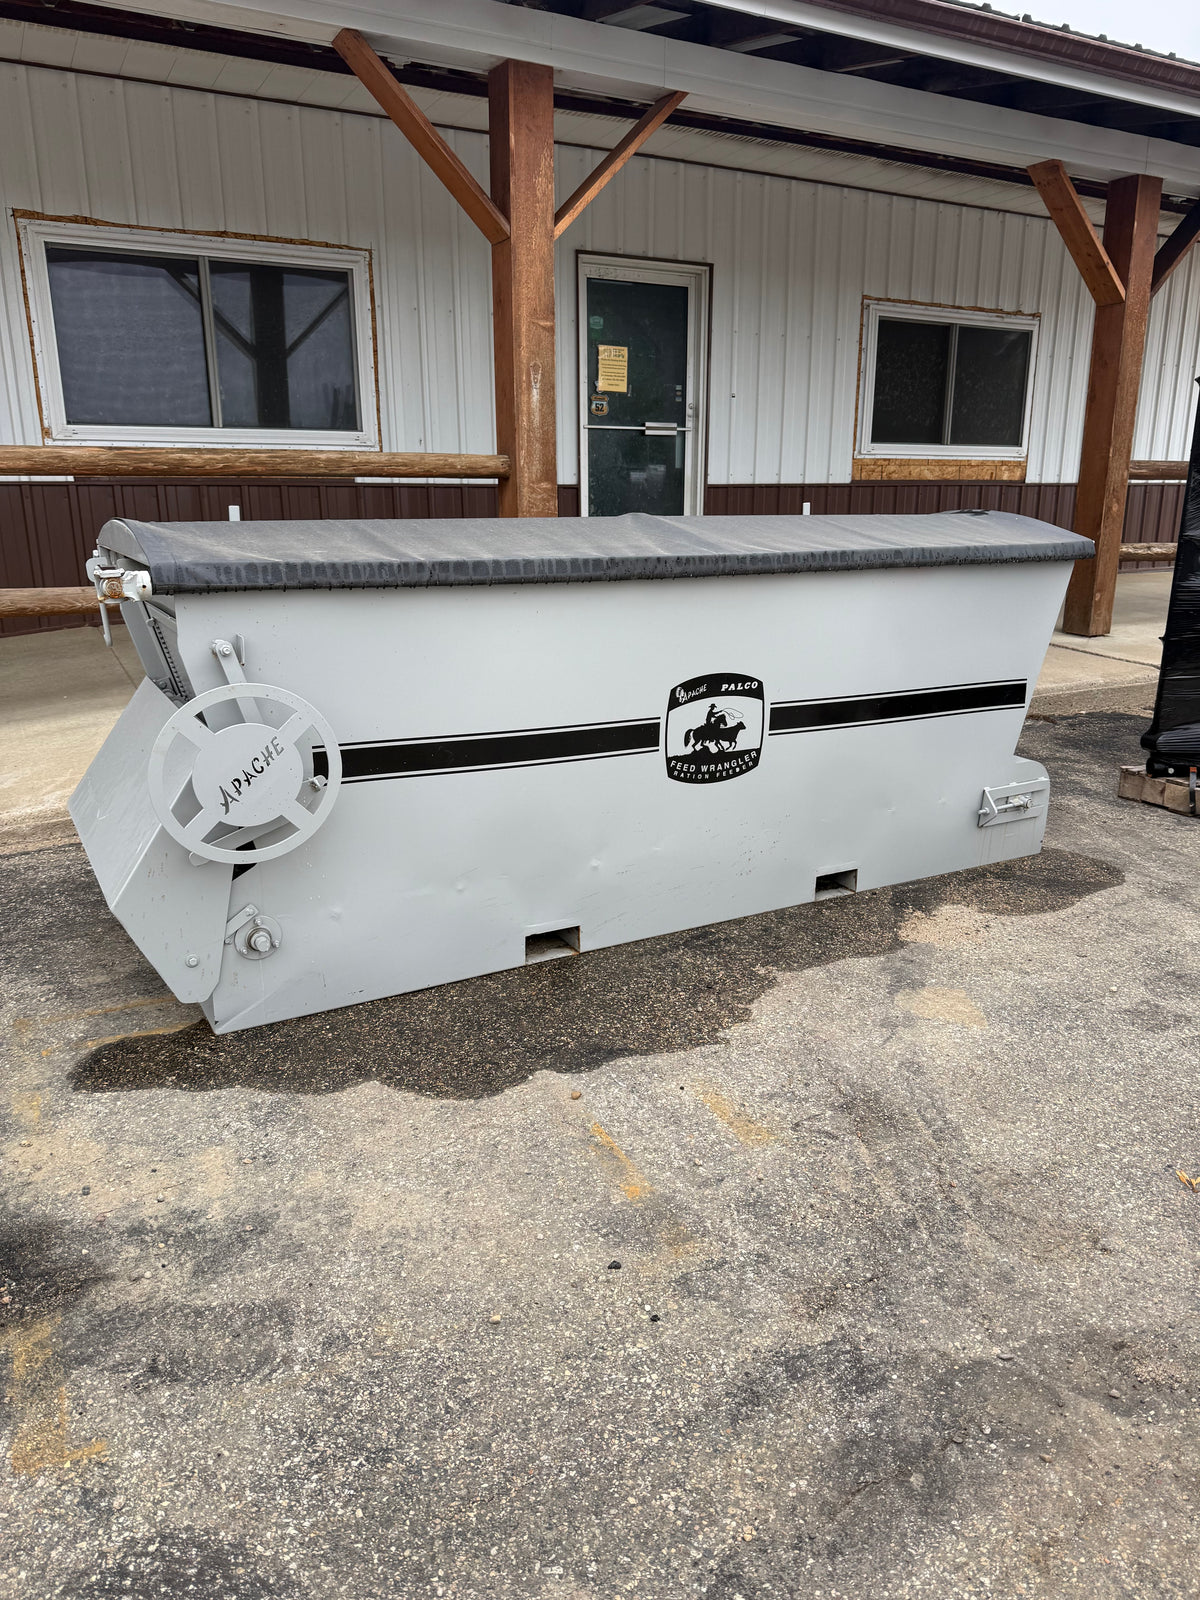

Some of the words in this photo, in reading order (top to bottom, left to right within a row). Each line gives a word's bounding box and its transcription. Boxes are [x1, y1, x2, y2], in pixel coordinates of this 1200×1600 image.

[595, 403, 604, 412] 52
[681, 683, 708, 703] APACHE
[720, 681, 758, 692] PALCO
[670, 760, 696, 772] FEED
[700, 751, 758, 773] WRANGLER
[673, 770, 709, 780] RATION
[716, 761, 753, 778] FEEDER
[218, 736, 285, 815] APACHE
